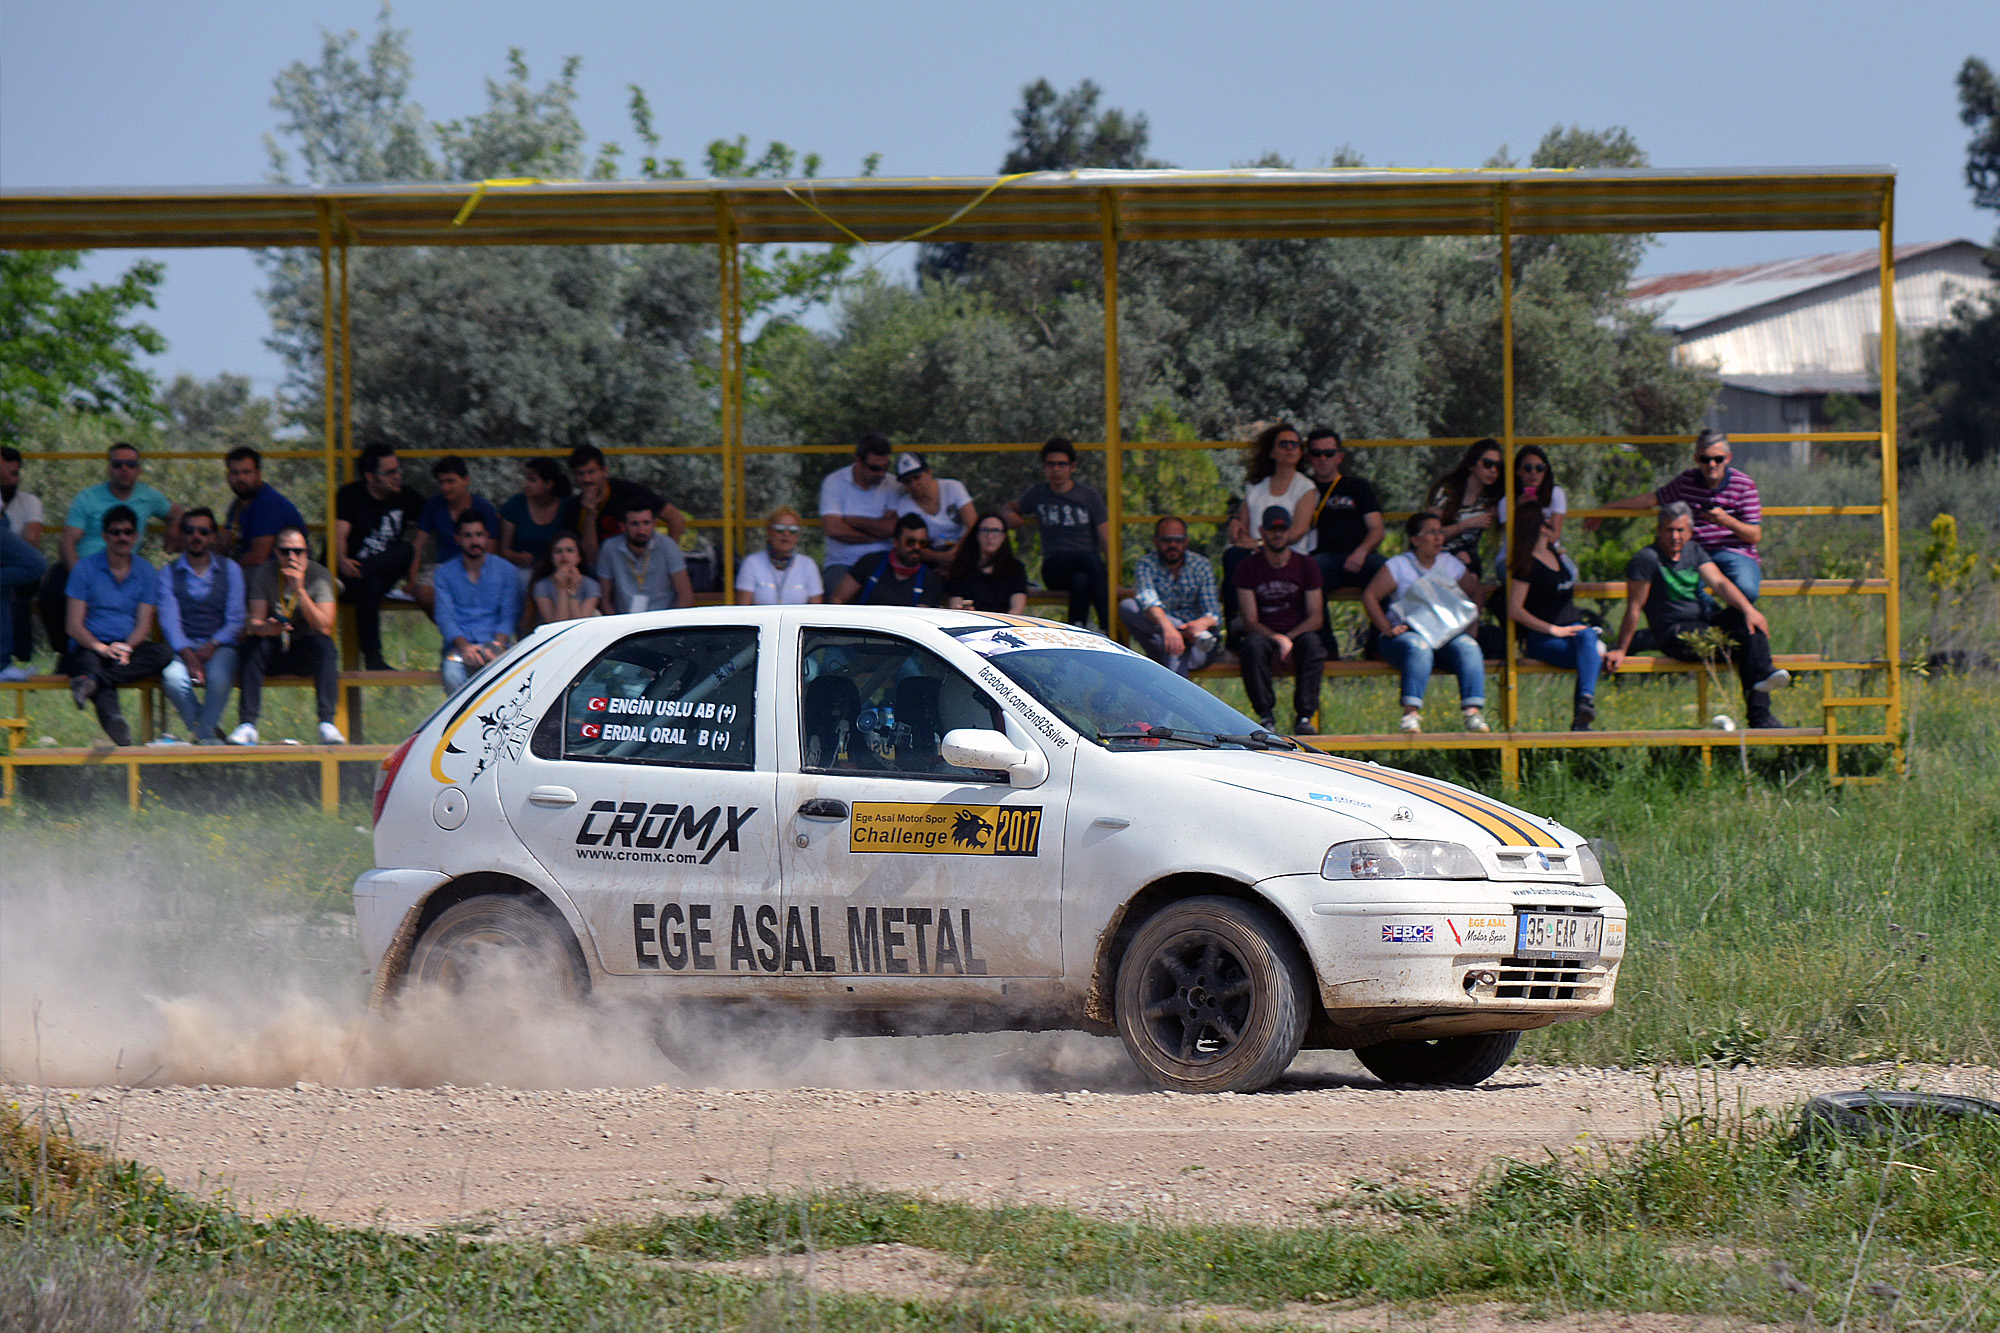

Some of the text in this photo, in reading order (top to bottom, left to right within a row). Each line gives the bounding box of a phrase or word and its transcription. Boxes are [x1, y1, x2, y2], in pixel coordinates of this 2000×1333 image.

[608, 696, 737, 724] ENGİN USLU AB (+)
[978, 666, 1069, 749] facebook.com/zen925silver
[503, 713, 534, 762] ZEN
[602, 724, 730, 751] ERDAL ORAL B (+)
[576, 800, 759, 864] CROMX
[856, 813, 948, 824] Ege Asal Motor Spor
[996, 810, 1041, 852] 2017
[853, 827, 948, 848] Challenge
[576, 849, 697, 864] www.cromx.com
[1393, 925, 1425, 938] EBC
[1469, 918, 1507, 927] EGE ASAL
[1527, 917, 1544, 946] 35
[1555, 918, 1577, 947] EAR
[1584, 919, 1598, 948] 41
[633, 903, 988, 975] EGE ASAL METAL
[1464, 929, 1507, 945] Motor Spor
